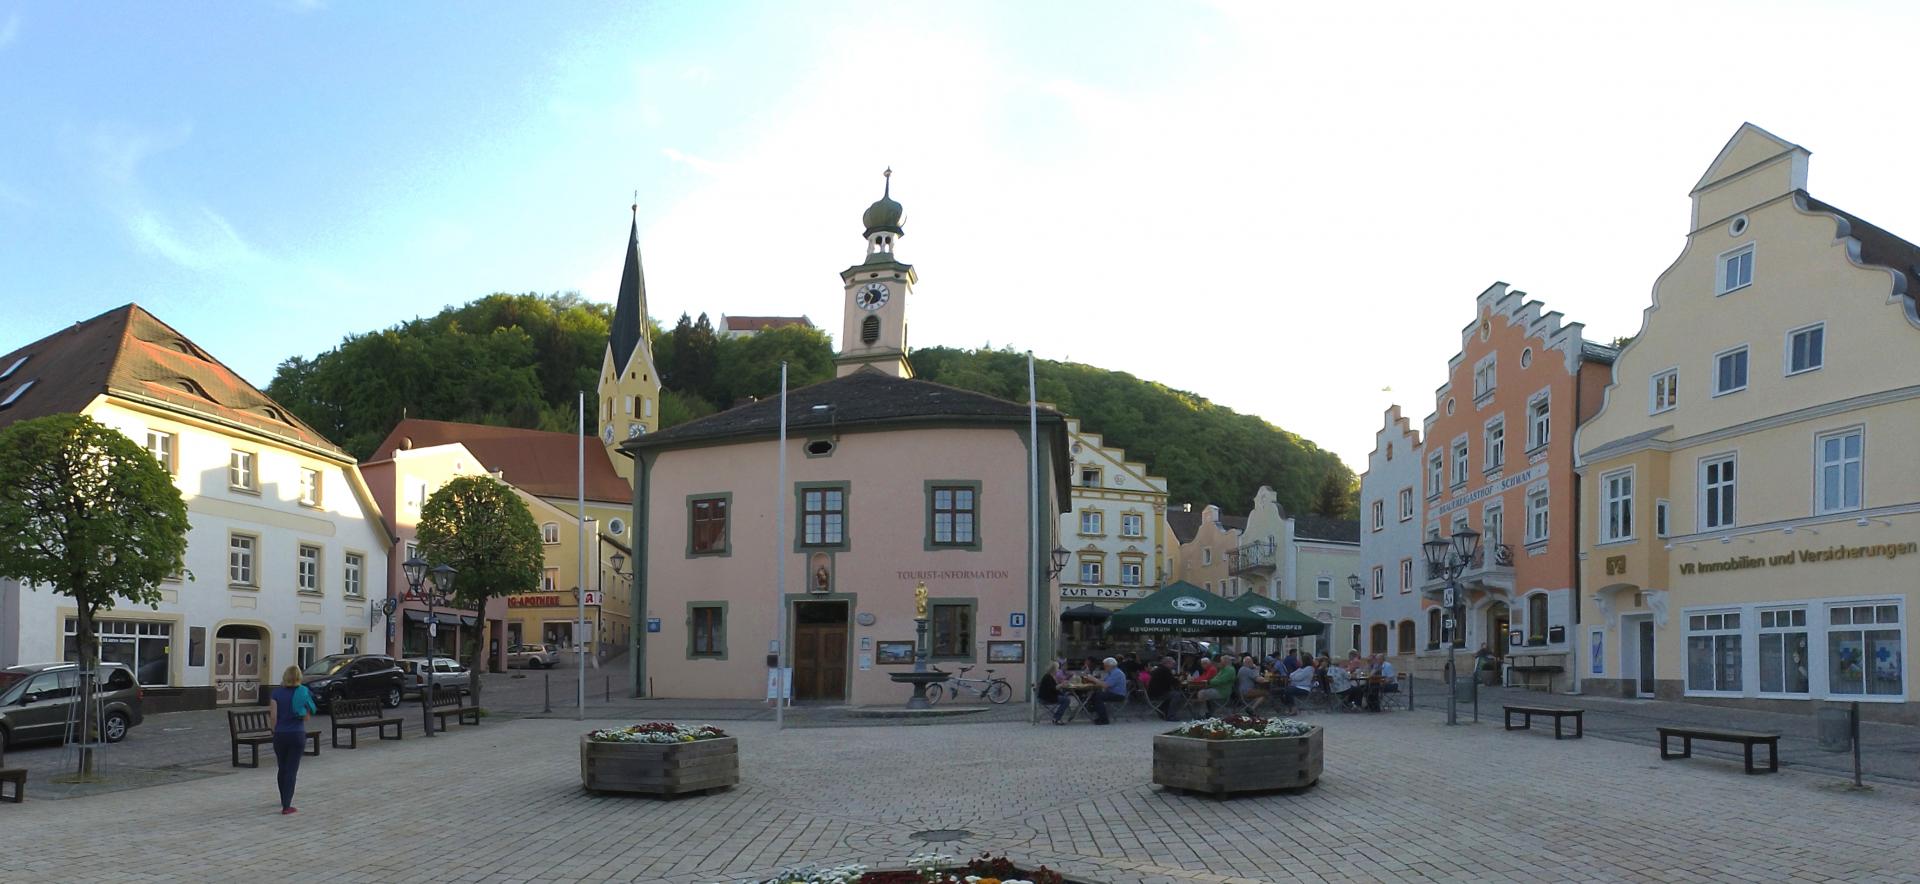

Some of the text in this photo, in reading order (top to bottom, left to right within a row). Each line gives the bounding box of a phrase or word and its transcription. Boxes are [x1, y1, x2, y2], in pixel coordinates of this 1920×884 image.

[1501, 471, 1531, 490] SCHWAN
[1679, 541, 1917, 575] VR Immobilien und Versicherungen
[896, 570, 1009, 579] TOURIST-INFORMATION
[1062, 588, 1128, 597] ZUR POST
[1144, 617, 1238, 627] BRAUEREI RIEMHOFER
